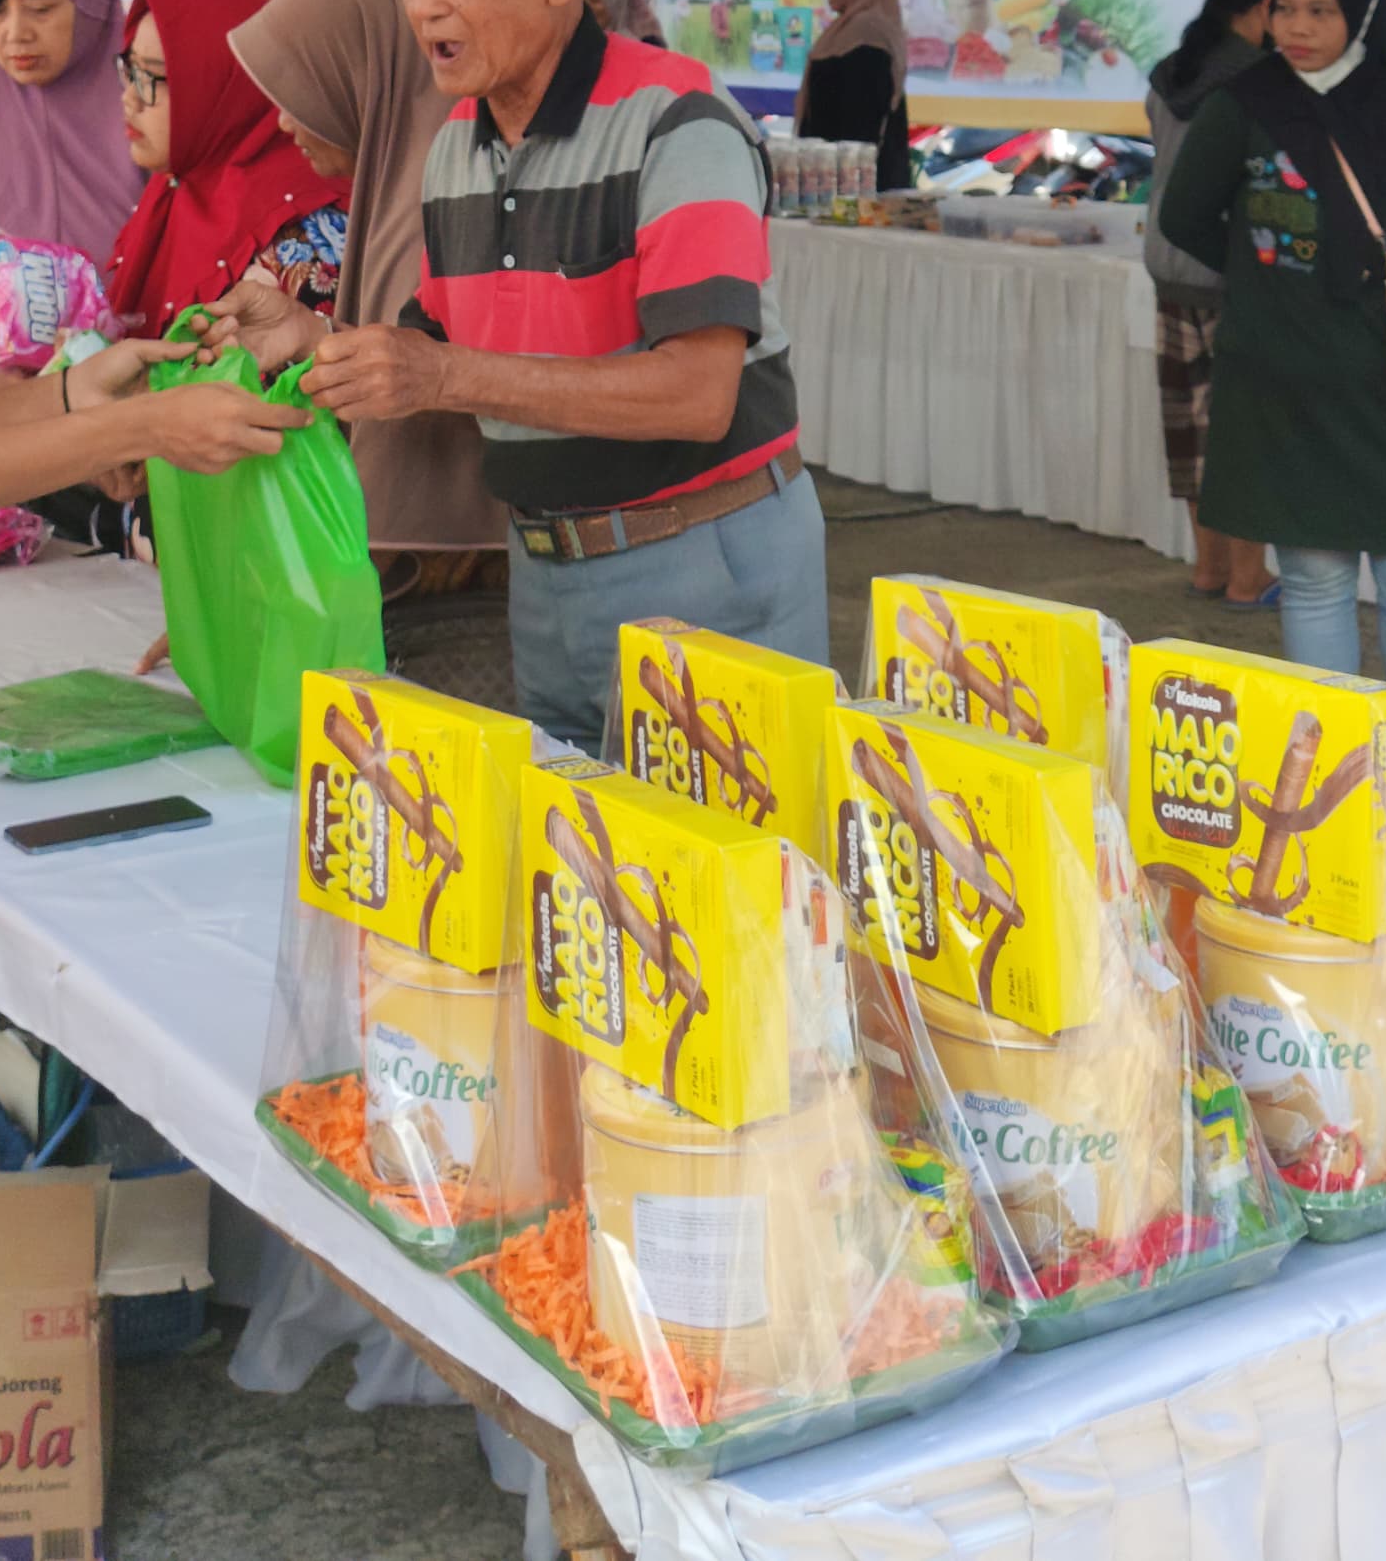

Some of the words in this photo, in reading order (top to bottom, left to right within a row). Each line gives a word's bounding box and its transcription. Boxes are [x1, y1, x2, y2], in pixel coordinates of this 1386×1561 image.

[1148, 705, 1241, 765] MAJO
[1176, 688, 1222, 713] Kokola
[646, 710, 669, 785] AJO
[326, 763, 351, 901] MAJO
[376, 804, 386, 897] CHOCOLATE
[1162, 803, 1233, 829] CHOCOLATE
[848, 820, 860, 894] Kokola
[541, 893, 552, 973] Kokola
[922, 847, 935, 947] CHOCOLATE
[552, 871, 583, 1032] MAJO
[608, 925, 622, 1031] CHOCOLATE
[394, 1056, 497, 1102] Coffee
[1256, 1028, 1371, 1070] Coffee
[995, 1123, 1118, 1165] Coffee
